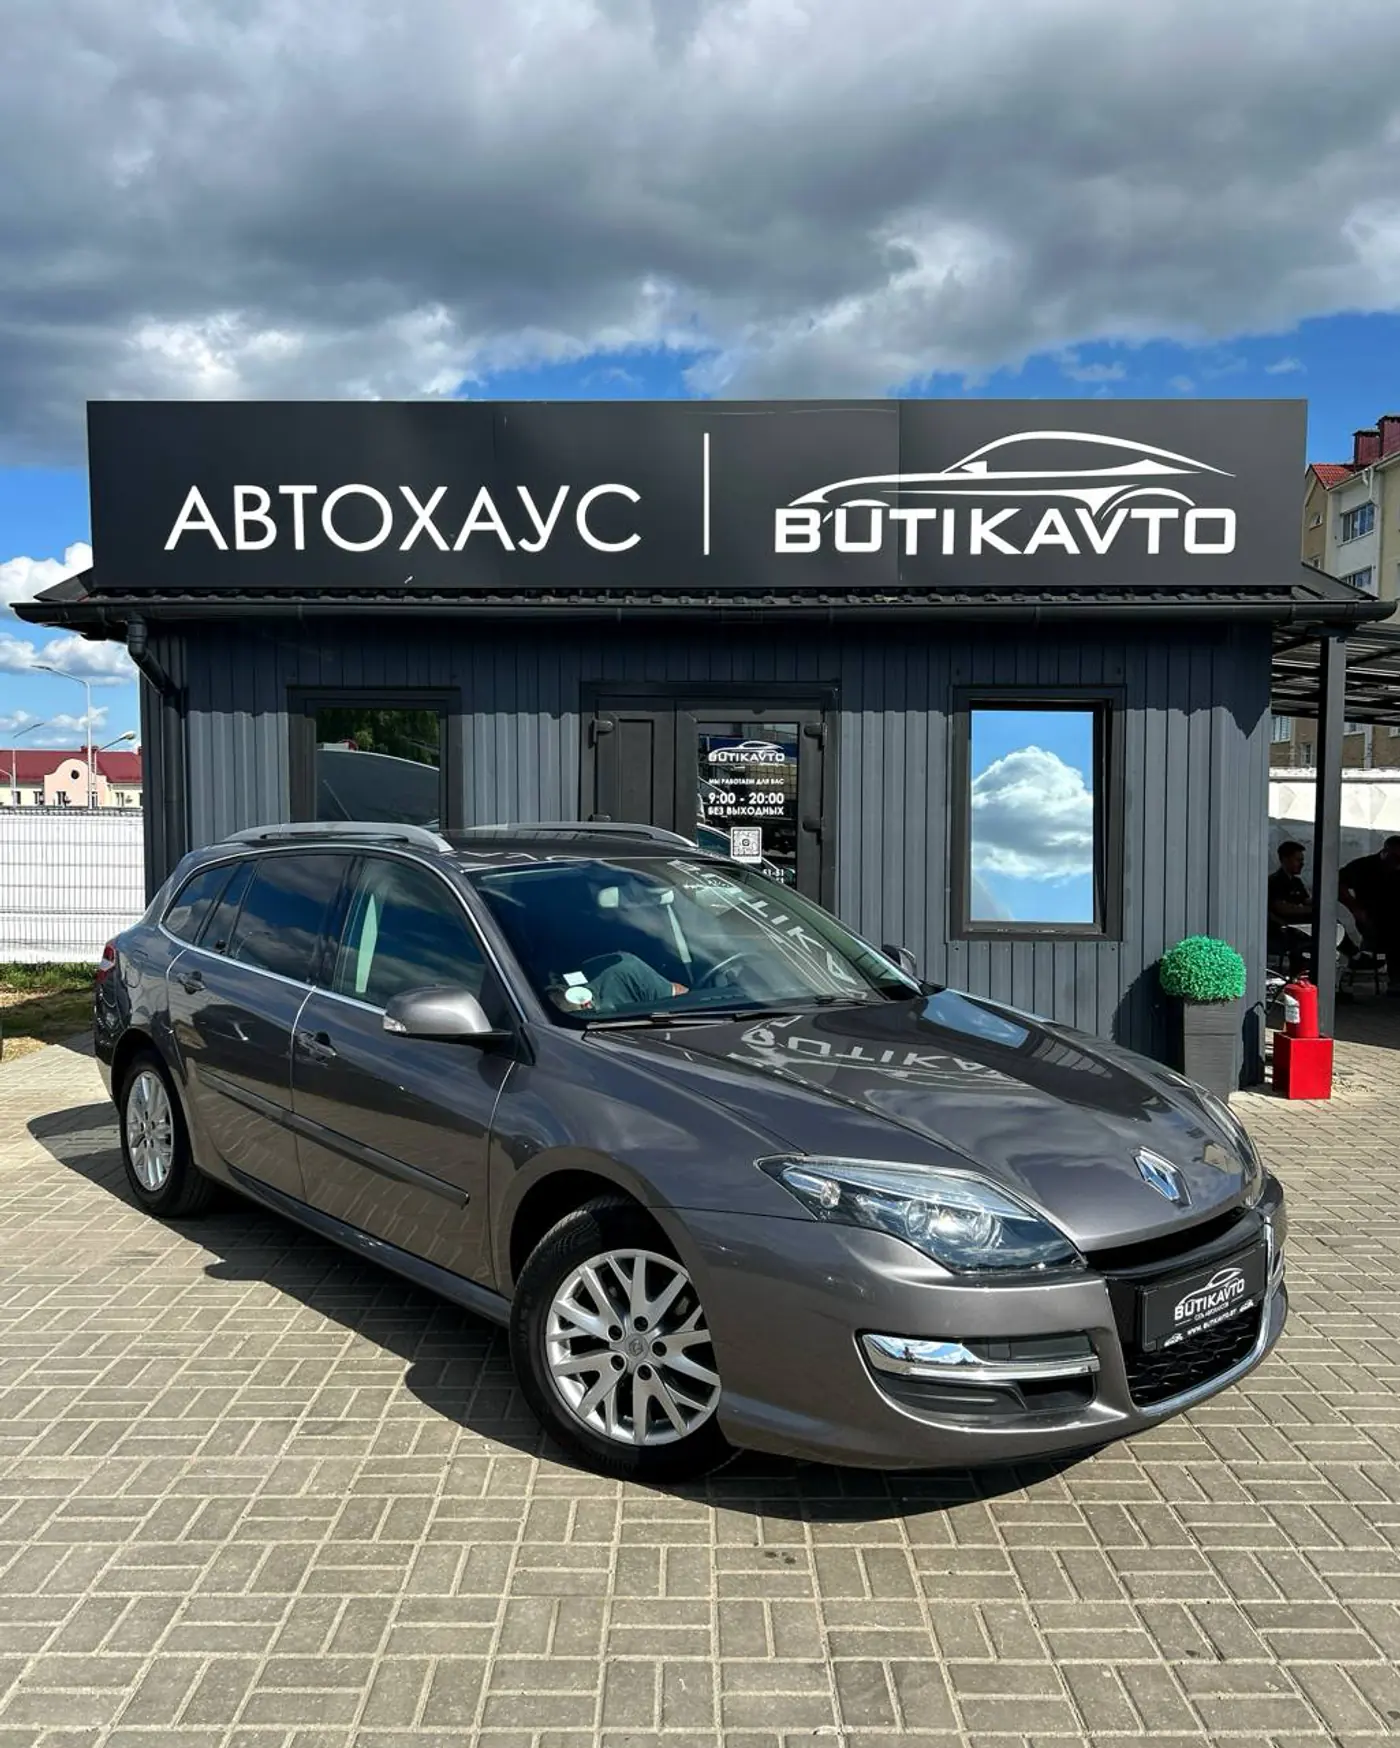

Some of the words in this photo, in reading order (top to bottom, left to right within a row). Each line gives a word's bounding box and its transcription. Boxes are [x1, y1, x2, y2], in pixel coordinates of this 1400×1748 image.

[164, 484, 641, 552] АВТОХАУС
[774, 508, 1236, 555] BUTIKAVTO
[708, 752, 785, 762] BUTIKAVTO
[707, 806, 724, 815] БЕЗ
[726, 806, 785, 816] ВЫХОДНЫХ
[708, 792, 736, 805] 9:00
[748, 792, 785, 805] 20:00
[1174, 1278, 1245, 1321] BUTIKAVTO
